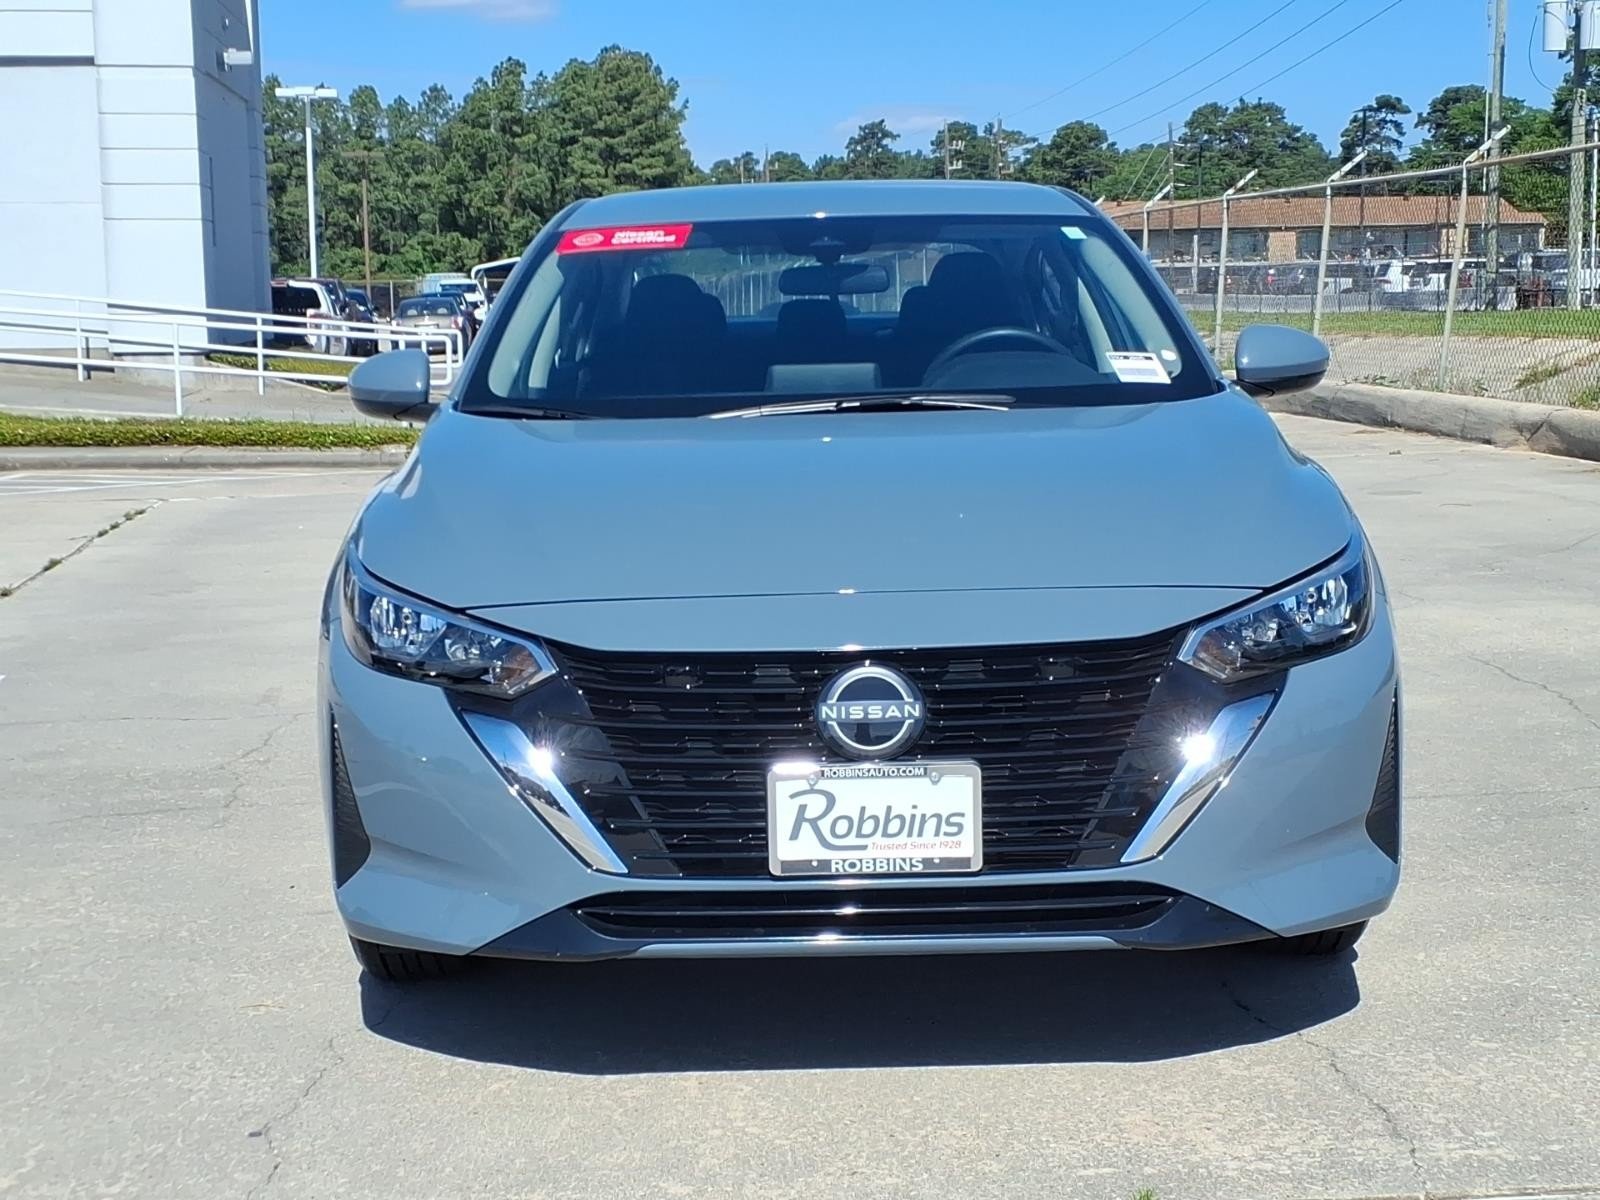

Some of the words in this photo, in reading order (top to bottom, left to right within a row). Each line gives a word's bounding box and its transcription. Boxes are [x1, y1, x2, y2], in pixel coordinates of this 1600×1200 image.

[821, 704, 920, 719] NISSAN
[824, 767, 925, 777] ROBBINSAUTO.COM
[788, 788, 965, 851] Robbins
[871, 842, 908, 851] Trusted
[910, 841, 937, 850] Since
[939, 840, 962, 849] 1928
[831, 857, 924, 873] ROBBINS
